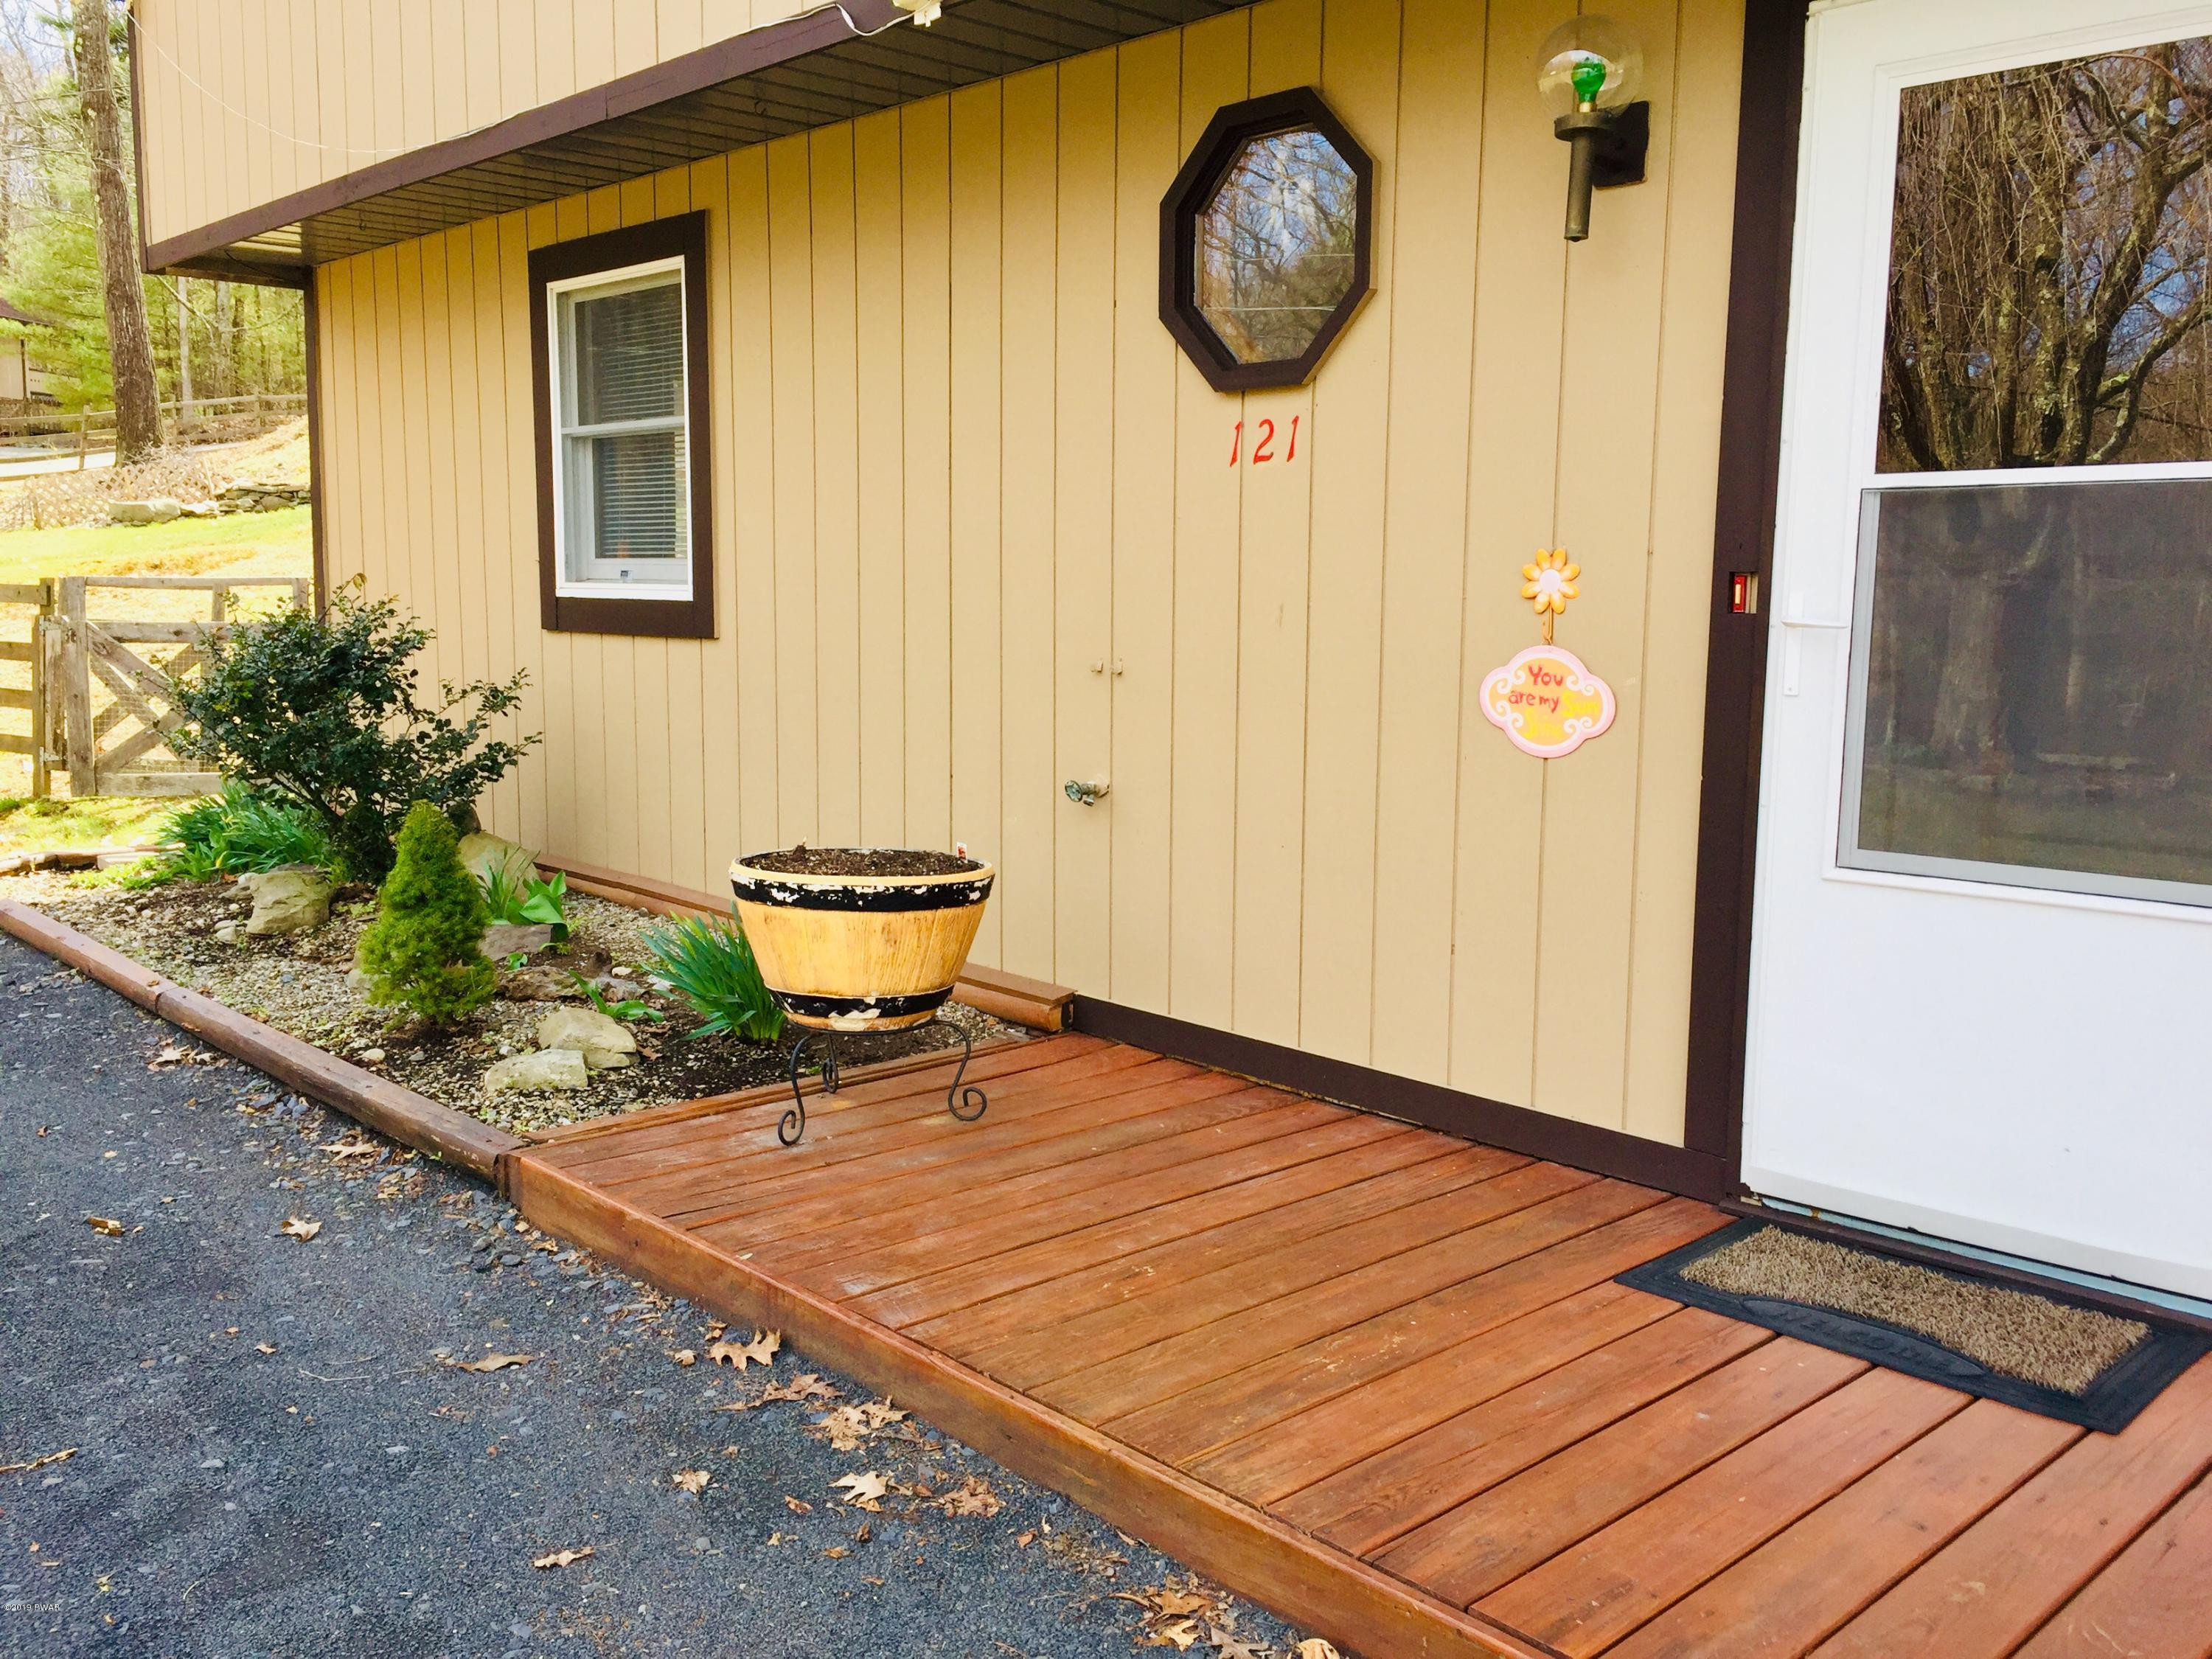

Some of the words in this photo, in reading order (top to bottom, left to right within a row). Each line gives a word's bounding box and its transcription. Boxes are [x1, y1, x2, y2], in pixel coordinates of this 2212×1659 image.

[1230, 415, 1299, 467] 121
[1528, 665, 1563, 686] You
[1509, 691, 1536, 706] are
[1539, 695, 1559, 714] my
